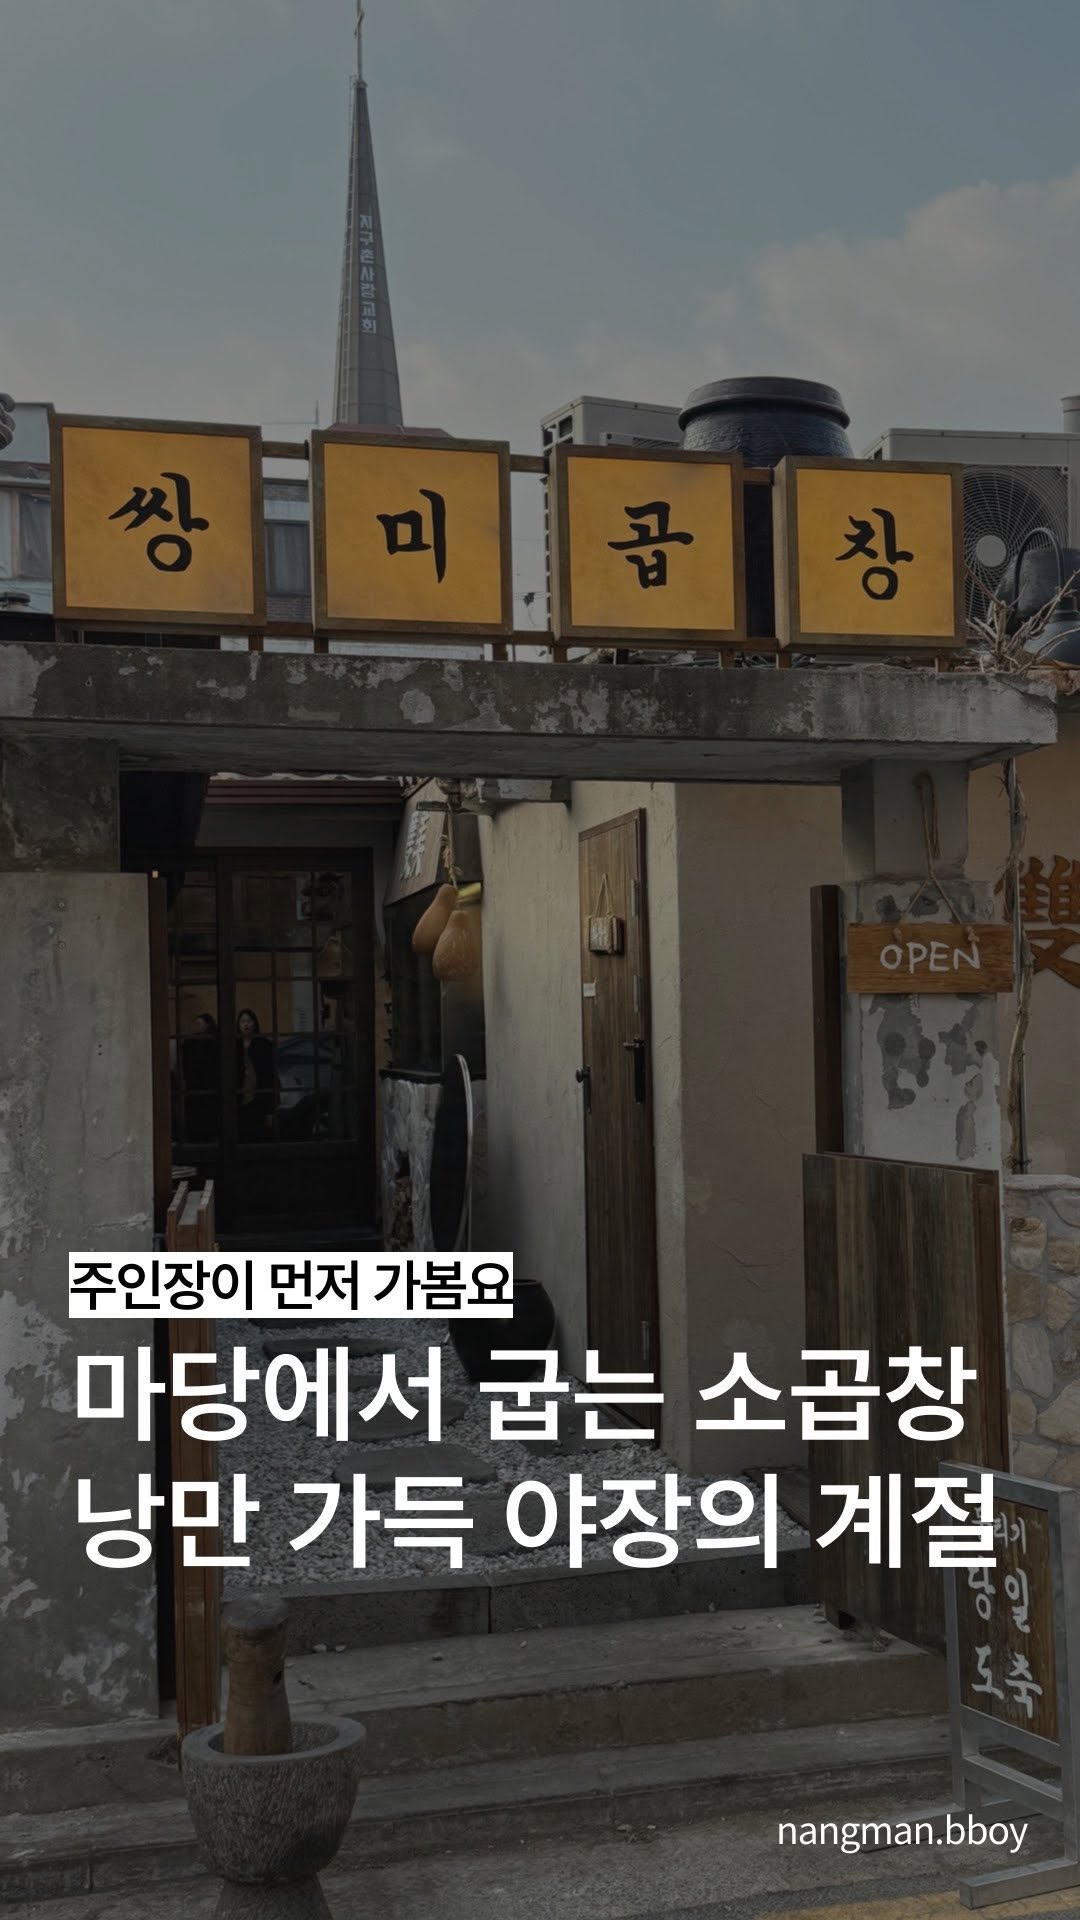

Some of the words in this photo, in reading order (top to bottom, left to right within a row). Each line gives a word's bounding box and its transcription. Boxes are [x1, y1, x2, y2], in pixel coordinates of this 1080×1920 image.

[360, 214, 377, 334] 지구촌사랑교회
[109, 473, 913, 599] 쌍미곱창
[880, 940, 981, 974] OPEN
[967, 1556, 1031, 1634] 당일
[971, 1645, 1043, 1718] 도축
